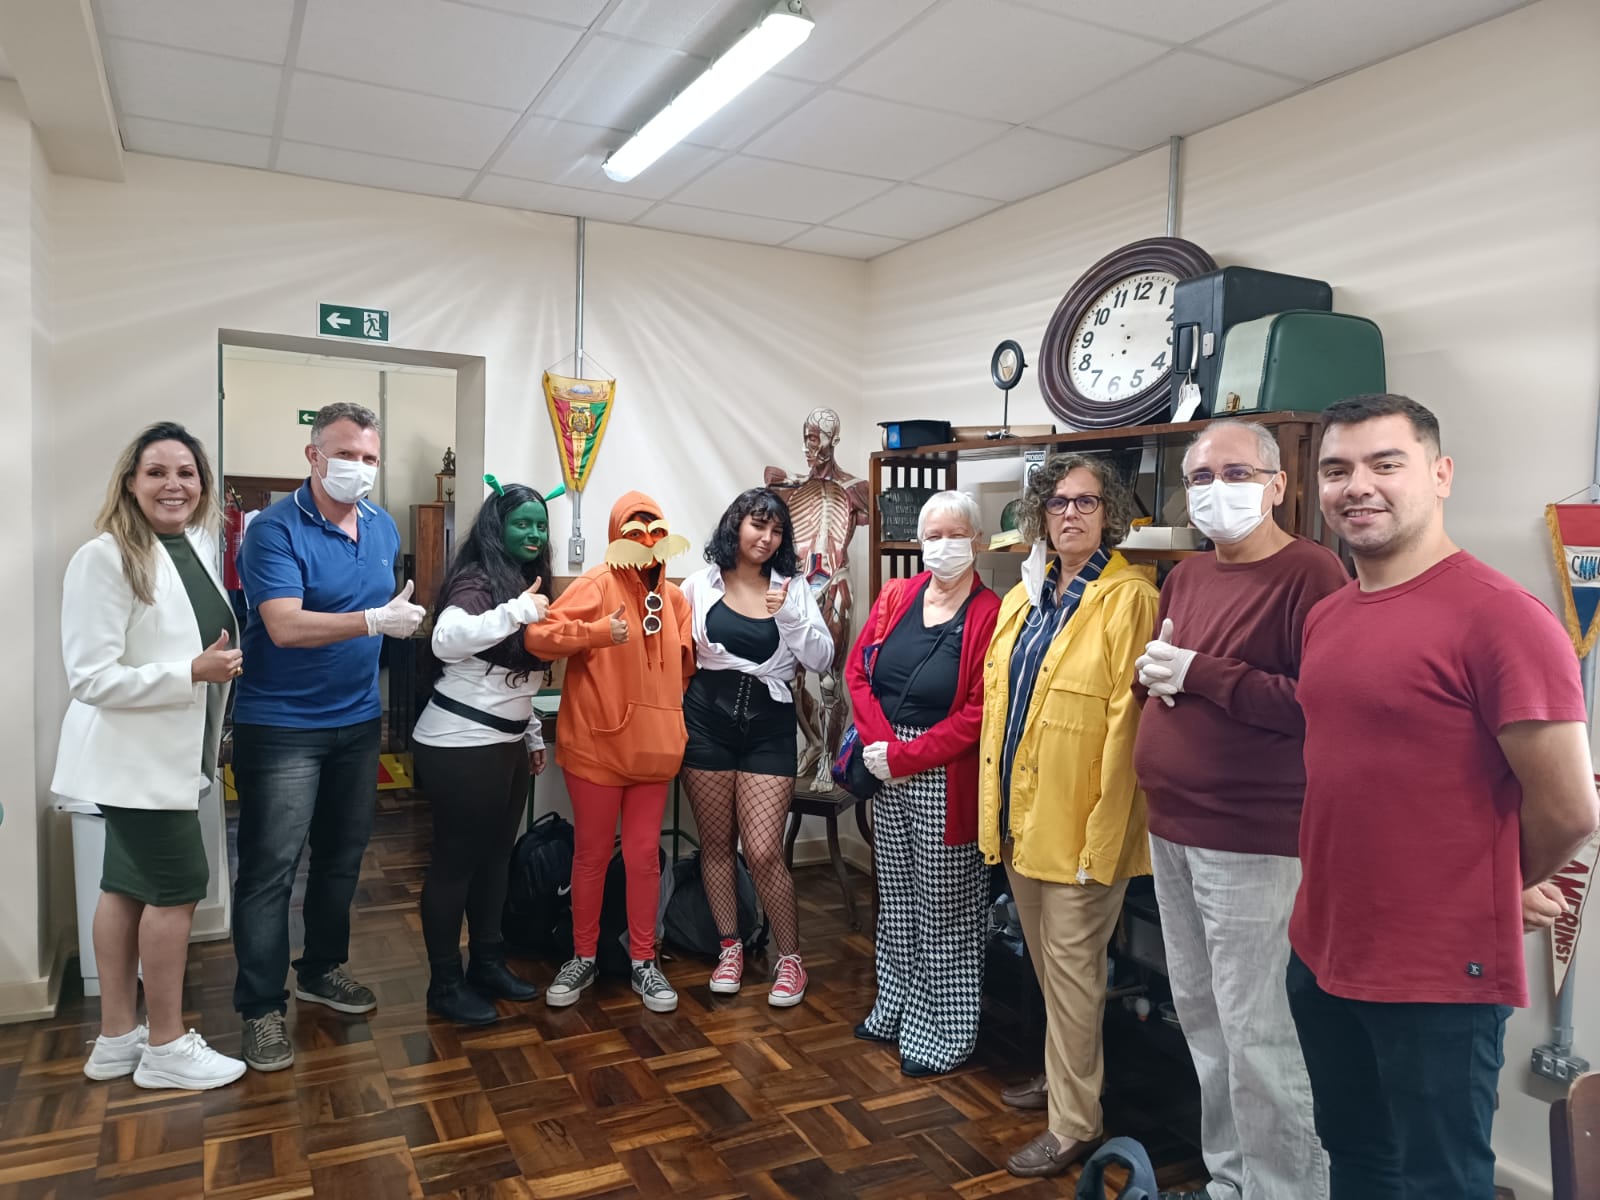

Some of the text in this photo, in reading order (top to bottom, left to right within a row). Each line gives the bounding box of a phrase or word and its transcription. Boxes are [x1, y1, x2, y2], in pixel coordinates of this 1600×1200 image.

[1113, 289, 1128, 308] 11
[1133, 282, 1153, 300] 12
[1158, 286, 1167, 305] 1
[1094, 307, 1110, 326] 10
[1081, 331, 1094, 349] 9
[1079, 354, 1092, 371] 8
[1151, 352, 1167, 370] 4
[1091, 370, 1103, 388] 7
[1107, 376, 1121, 394] 6
[1130, 369, 1144, 388] 5
